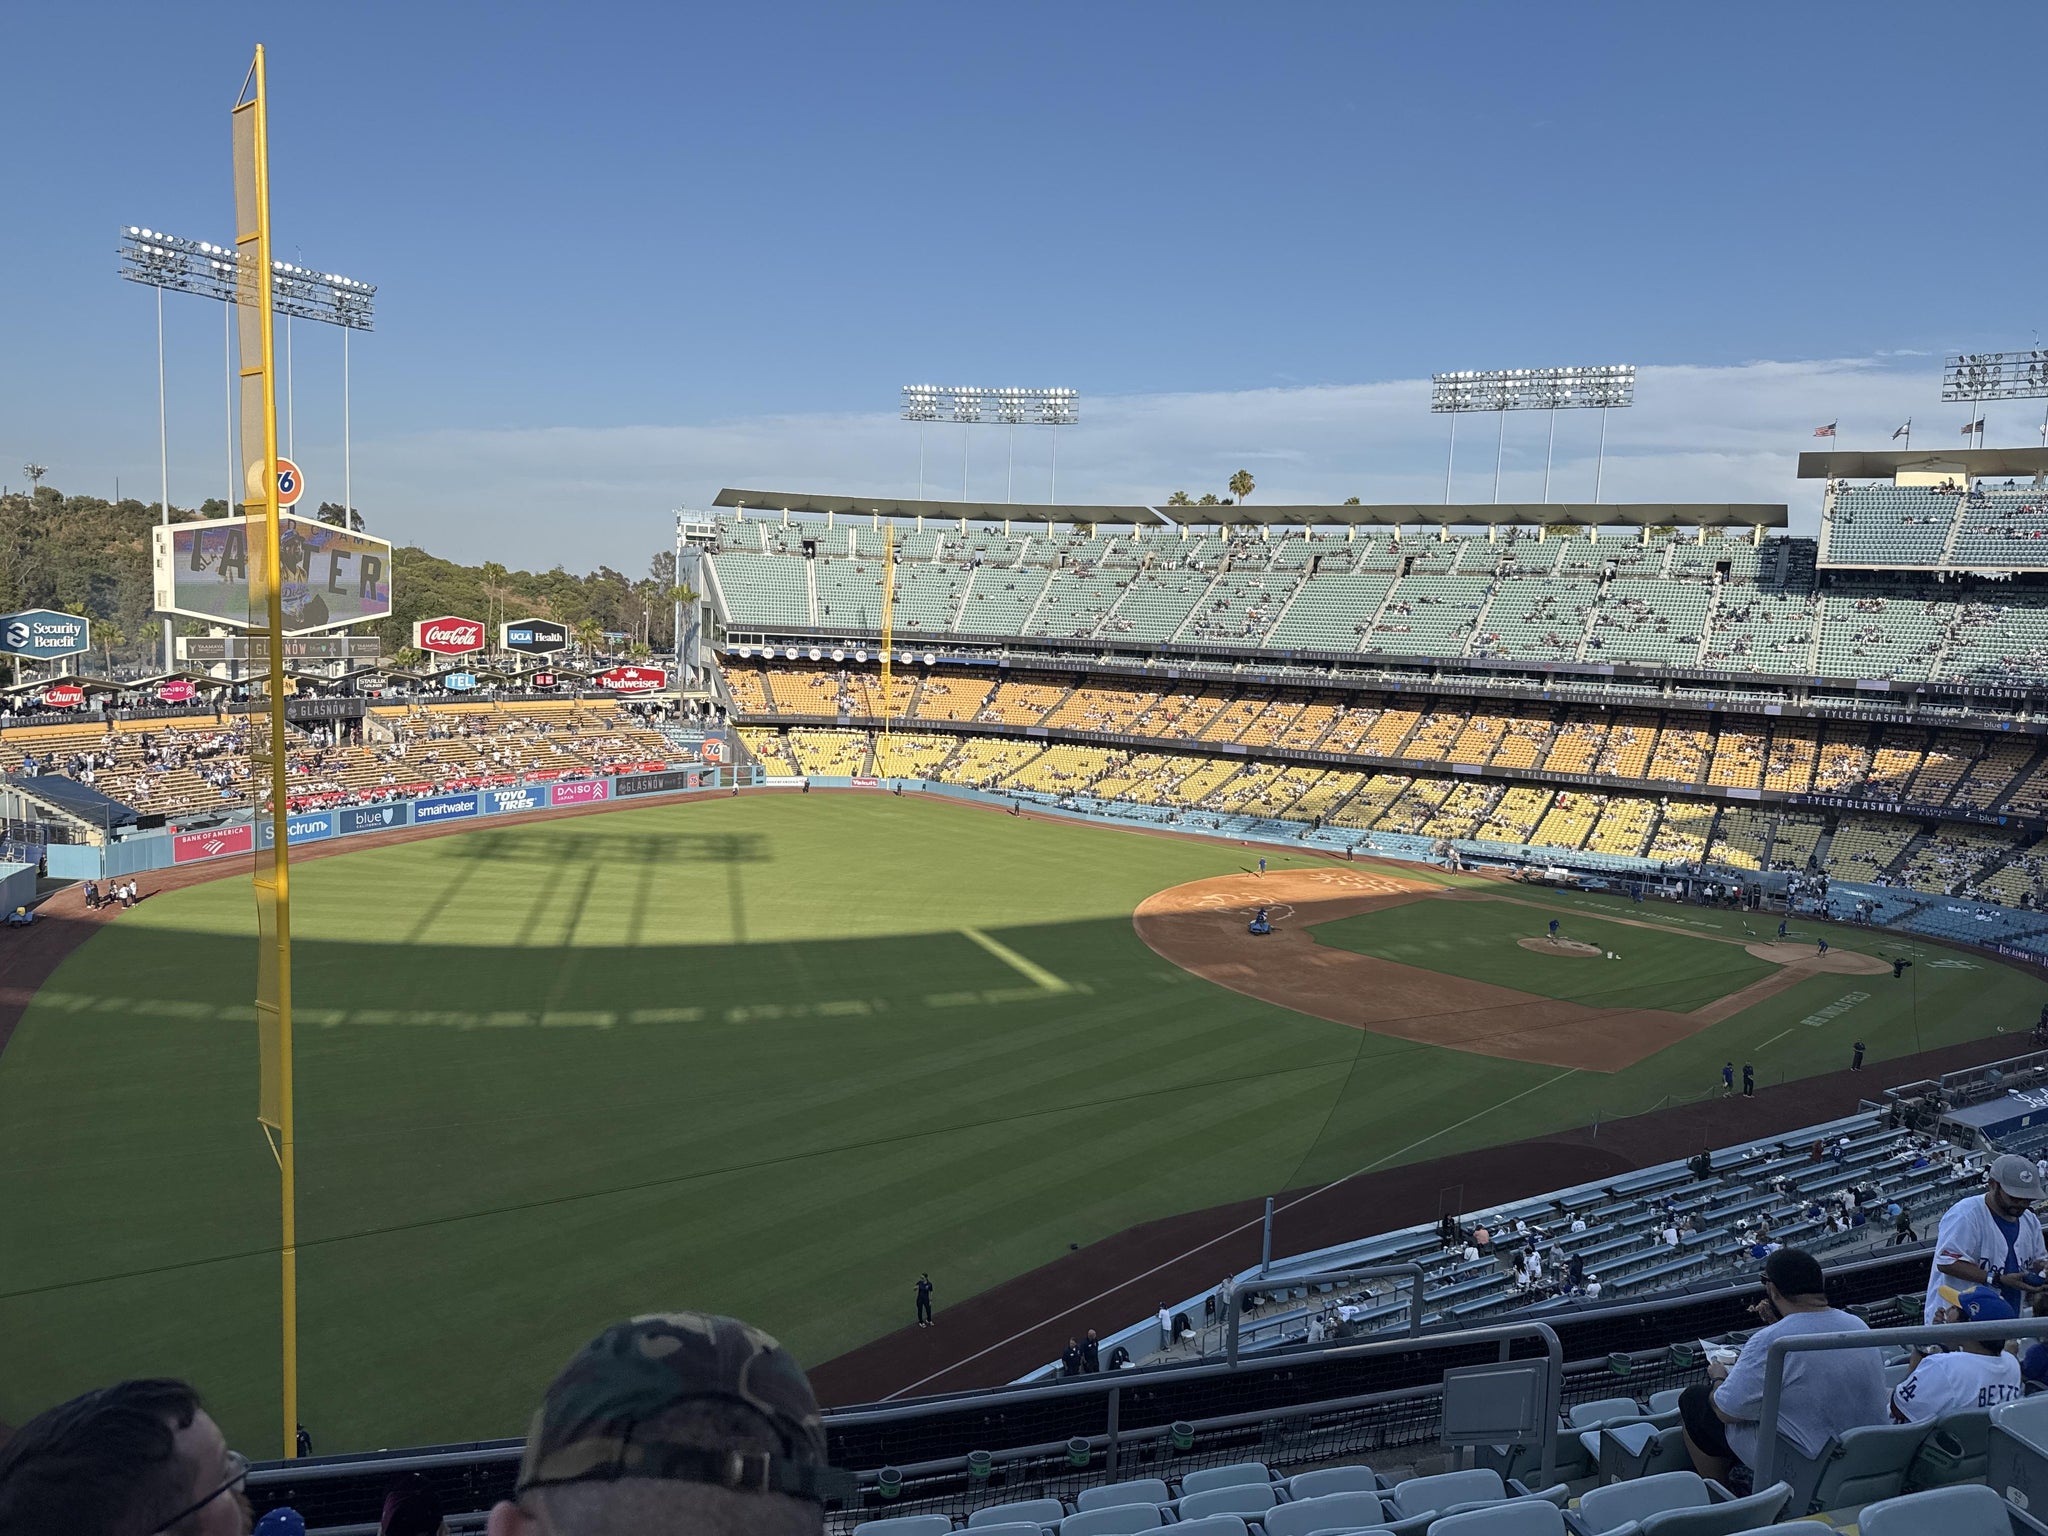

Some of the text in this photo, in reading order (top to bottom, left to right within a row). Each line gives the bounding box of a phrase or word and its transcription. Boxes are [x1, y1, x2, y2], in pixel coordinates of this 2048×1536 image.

[34, 622, 81, 636] Security
[35, 635, 76, 648] Benefit
[425, 626, 479, 645] Coca-Cola
[510, 632, 563, 642] UCLA Health
[1652, 669, 1732, 681] TYLER GLASNOW
[450, 676, 472, 687] TEL
[602, 677, 660, 689] Budweiser
[46, 691, 81, 703] Churu
[1935, 685, 1969, 695] TYLER
[1974, 688, 2027, 698] GLASNOW
[1566, 694, 1593, 703] TYLER
[301, 704, 346, 716] GLASNOW
[1733, 704, 1761, 713] TYLER
[1824, 709, 1913, 723] TYLER GLASNOW
[1984, 721, 2001, 729] blue
[706, 745, 721, 755] 76
[1279, 750, 1307, 759] TYLER
[690, 776, 698, 784] 76
[852, 778, 877, 787] Yakult
[1521, 771, 1602, 785] TYLER GLASNOW
[557, 784, 591, 796] DAISO
[626, 778, 664, 792] GLASNOW
[494, 789, 527, 802] TOYO
[418, 800, 475, 817] smartwater
[499, 798, 534, 811] TIRES
[1807, 795, 1902, 813] TYLER GLASNOW
[356, 811, 382, 825] blue
[1979, 814, 1998, 823] blue
[182, 827, 244, 843] BANK OF AMERICA
[265, 820, 325, 841] Sectrum
